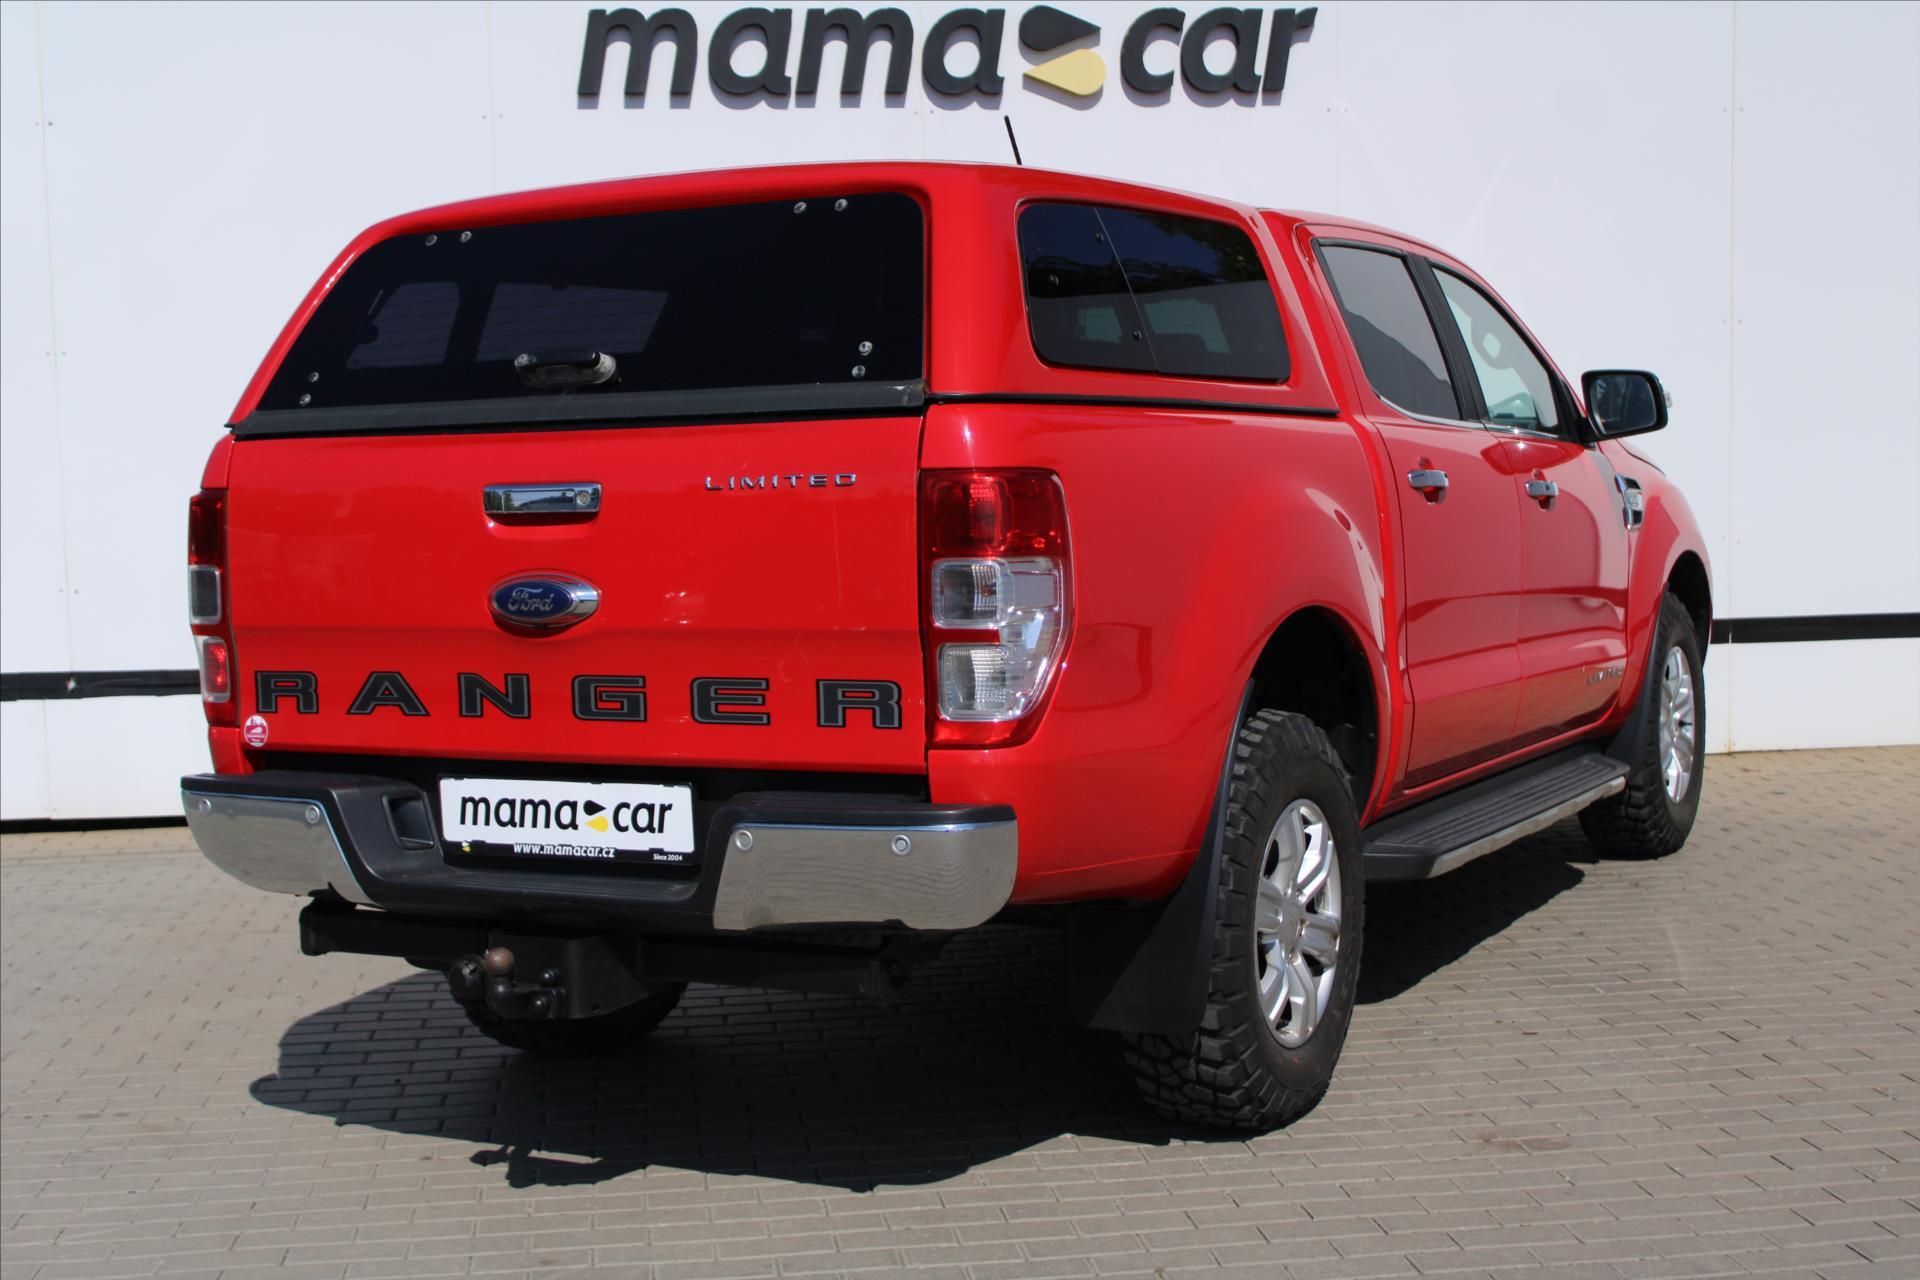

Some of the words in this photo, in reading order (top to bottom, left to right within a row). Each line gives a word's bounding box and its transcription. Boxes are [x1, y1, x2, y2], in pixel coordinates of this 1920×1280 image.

[1120, 7, 1318, 97] car
[704, 473, 857, 491] LIMITED
[507, 586, 555, 612] Ford
[254, 671, 902, 729] RANGER
[612, 802, 673, 834] car
[513, 843, 615, 858] www.mamacar.cz
